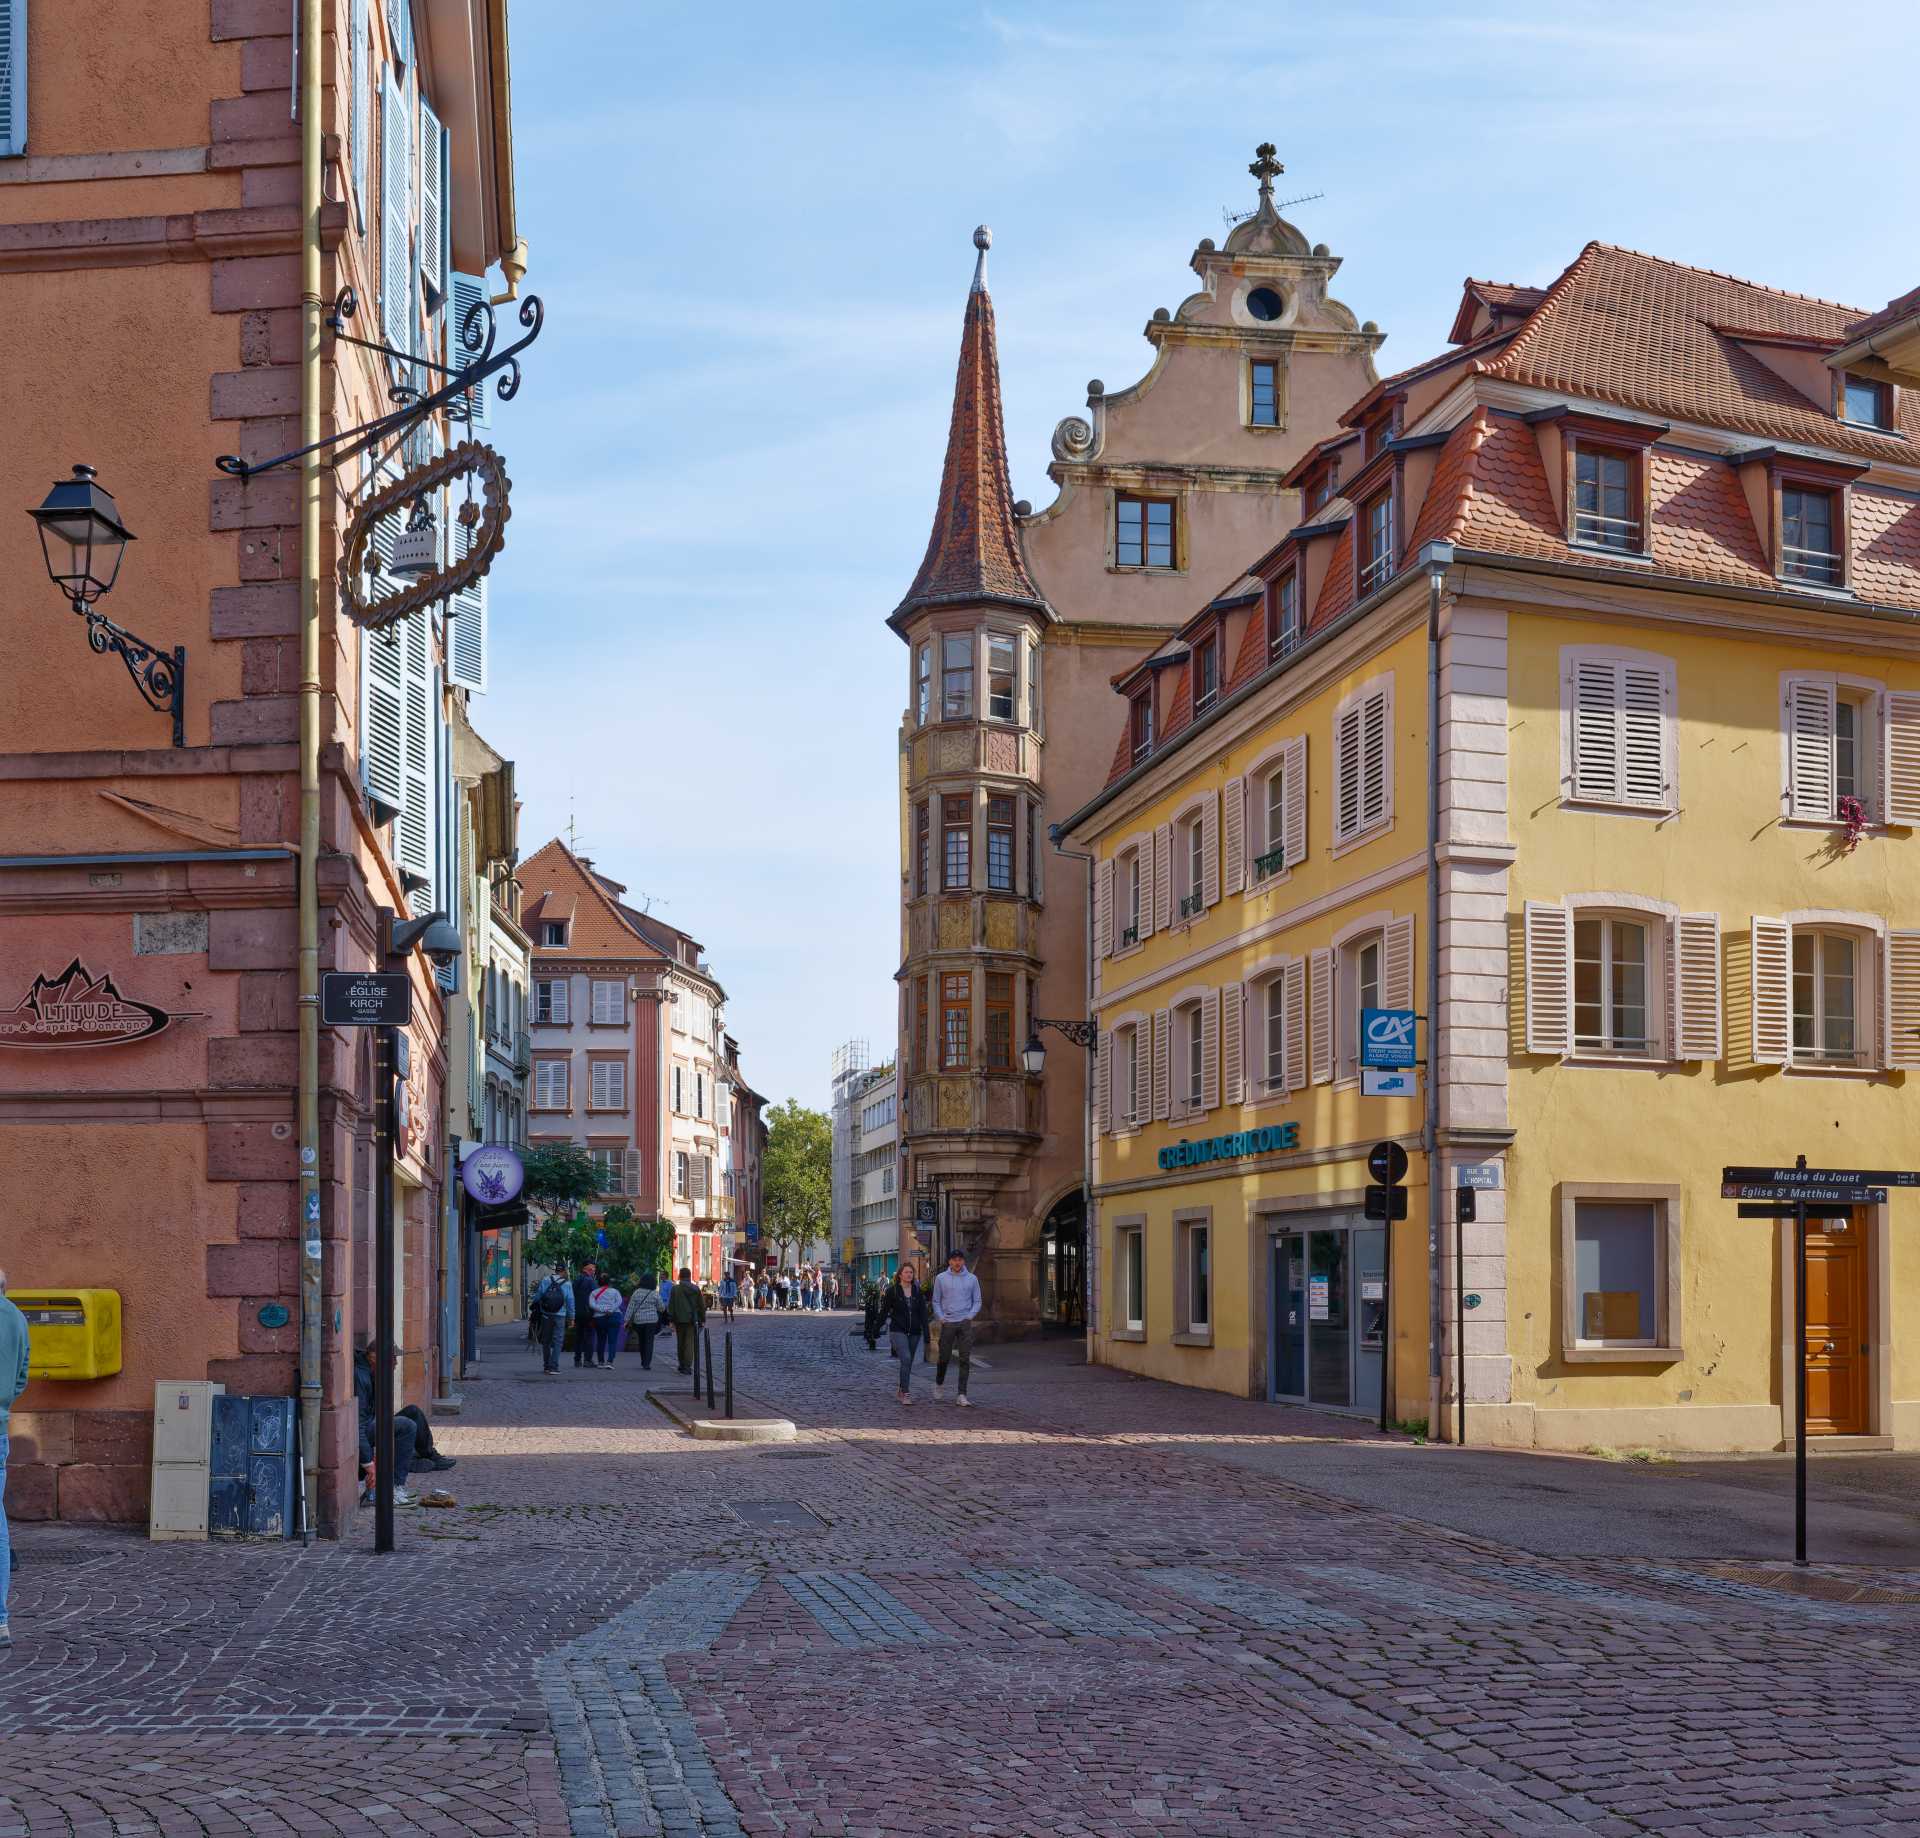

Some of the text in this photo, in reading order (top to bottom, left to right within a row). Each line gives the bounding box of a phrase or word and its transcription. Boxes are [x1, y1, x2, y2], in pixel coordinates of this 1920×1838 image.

[349, 1000, 383, 1008] KIRCH
[1158, 1121, 1298, 1169] CRÉDIT AGRICOLE
[1774, 1171, 1861, 1183] Musée du Jouet
[1741, 1186, 1773, 1199] Église
[1790, 1189, 1839, 1199] Matthieu
